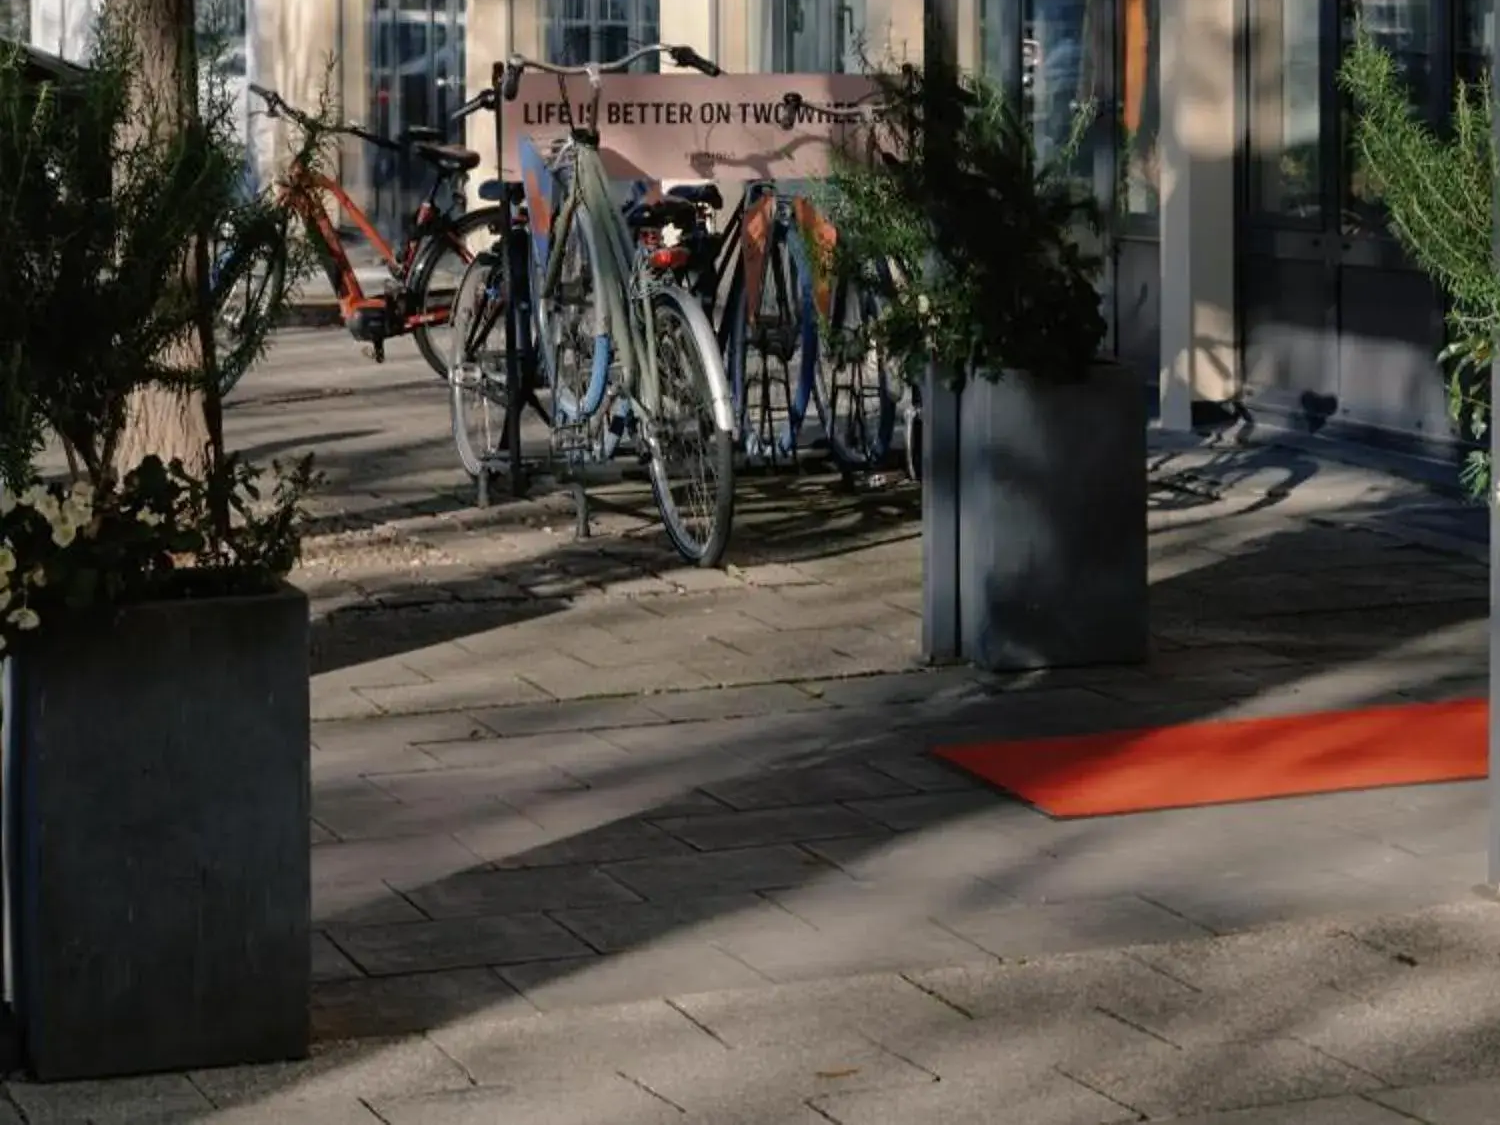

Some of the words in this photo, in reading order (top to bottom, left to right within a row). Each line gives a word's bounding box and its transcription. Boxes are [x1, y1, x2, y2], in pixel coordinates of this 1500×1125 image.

[523, 102, 571, 125] LIFE
[607, 102, 693, 125] BETTER
[699, 102, 734, 125] ON
